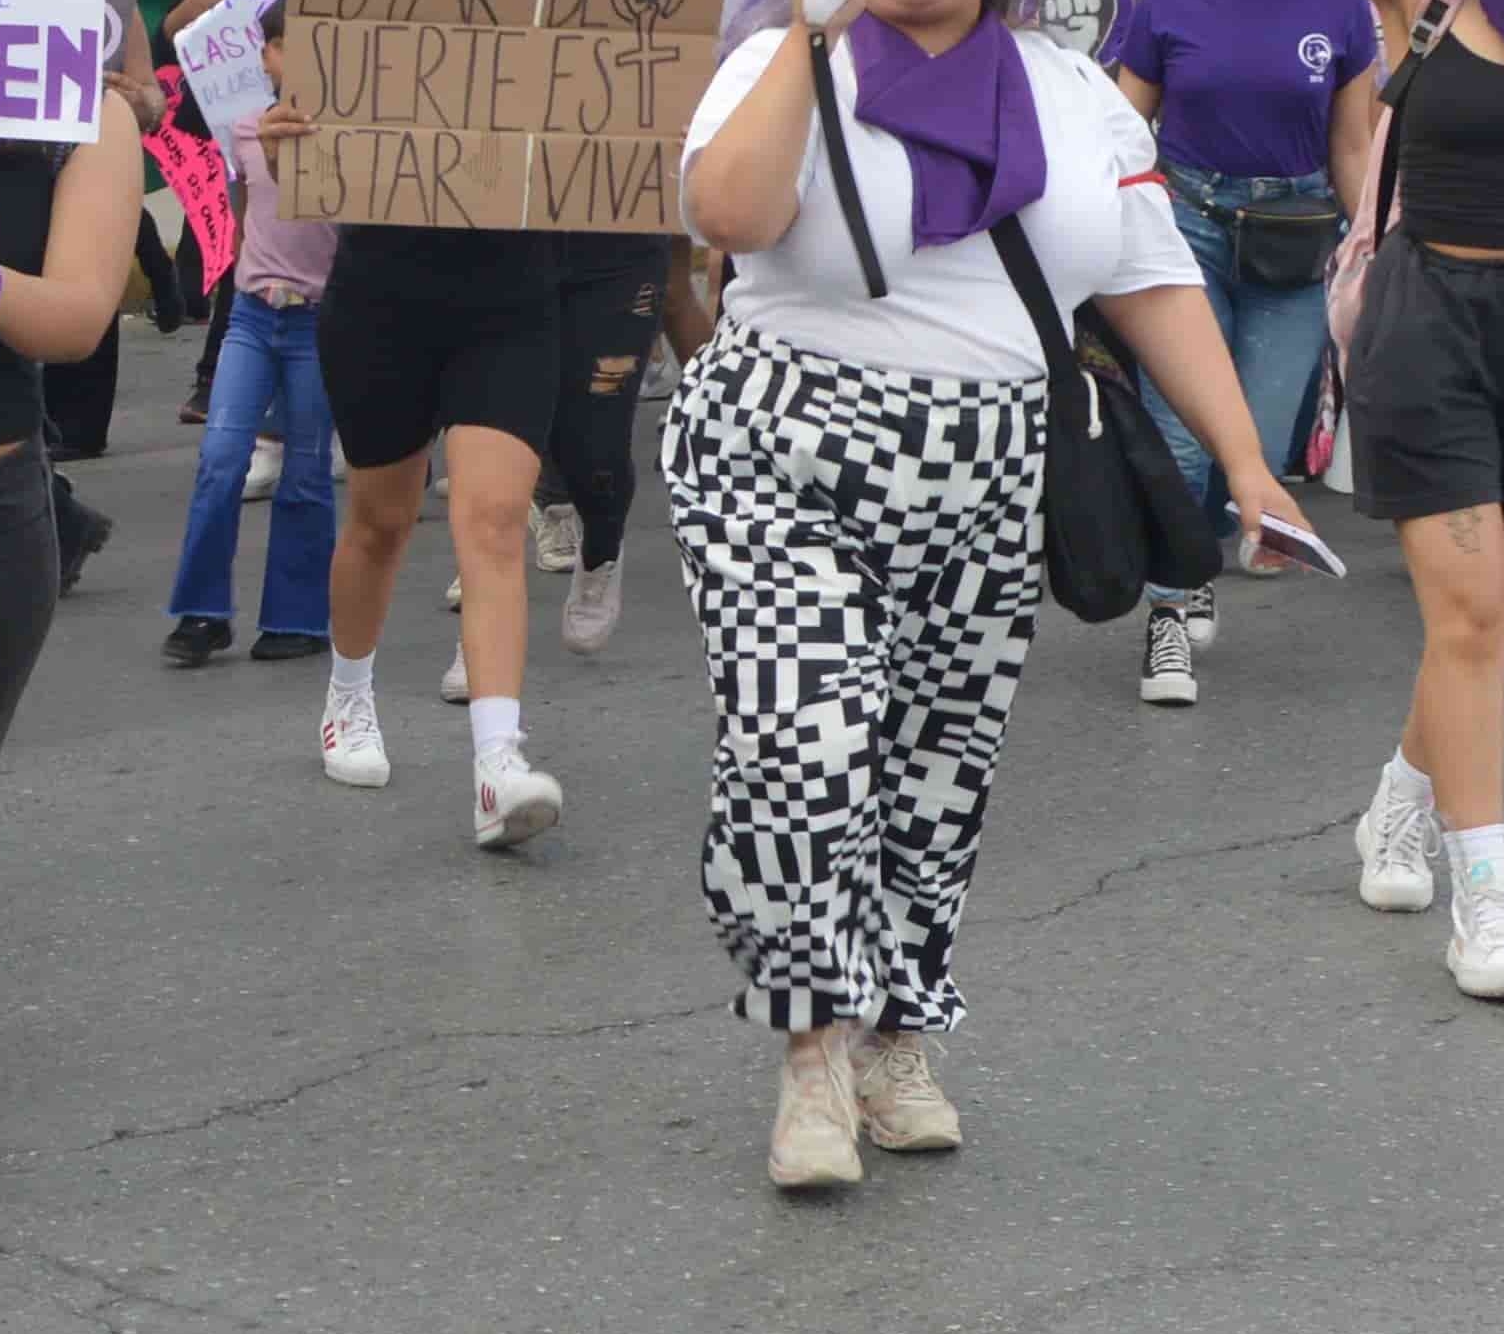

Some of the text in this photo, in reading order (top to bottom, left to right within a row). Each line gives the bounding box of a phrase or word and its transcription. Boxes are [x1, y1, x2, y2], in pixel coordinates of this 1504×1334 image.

[291, 20, 615, 137] SUERTE ES
[294, 129, 667, 230] ESTAR VIVA
